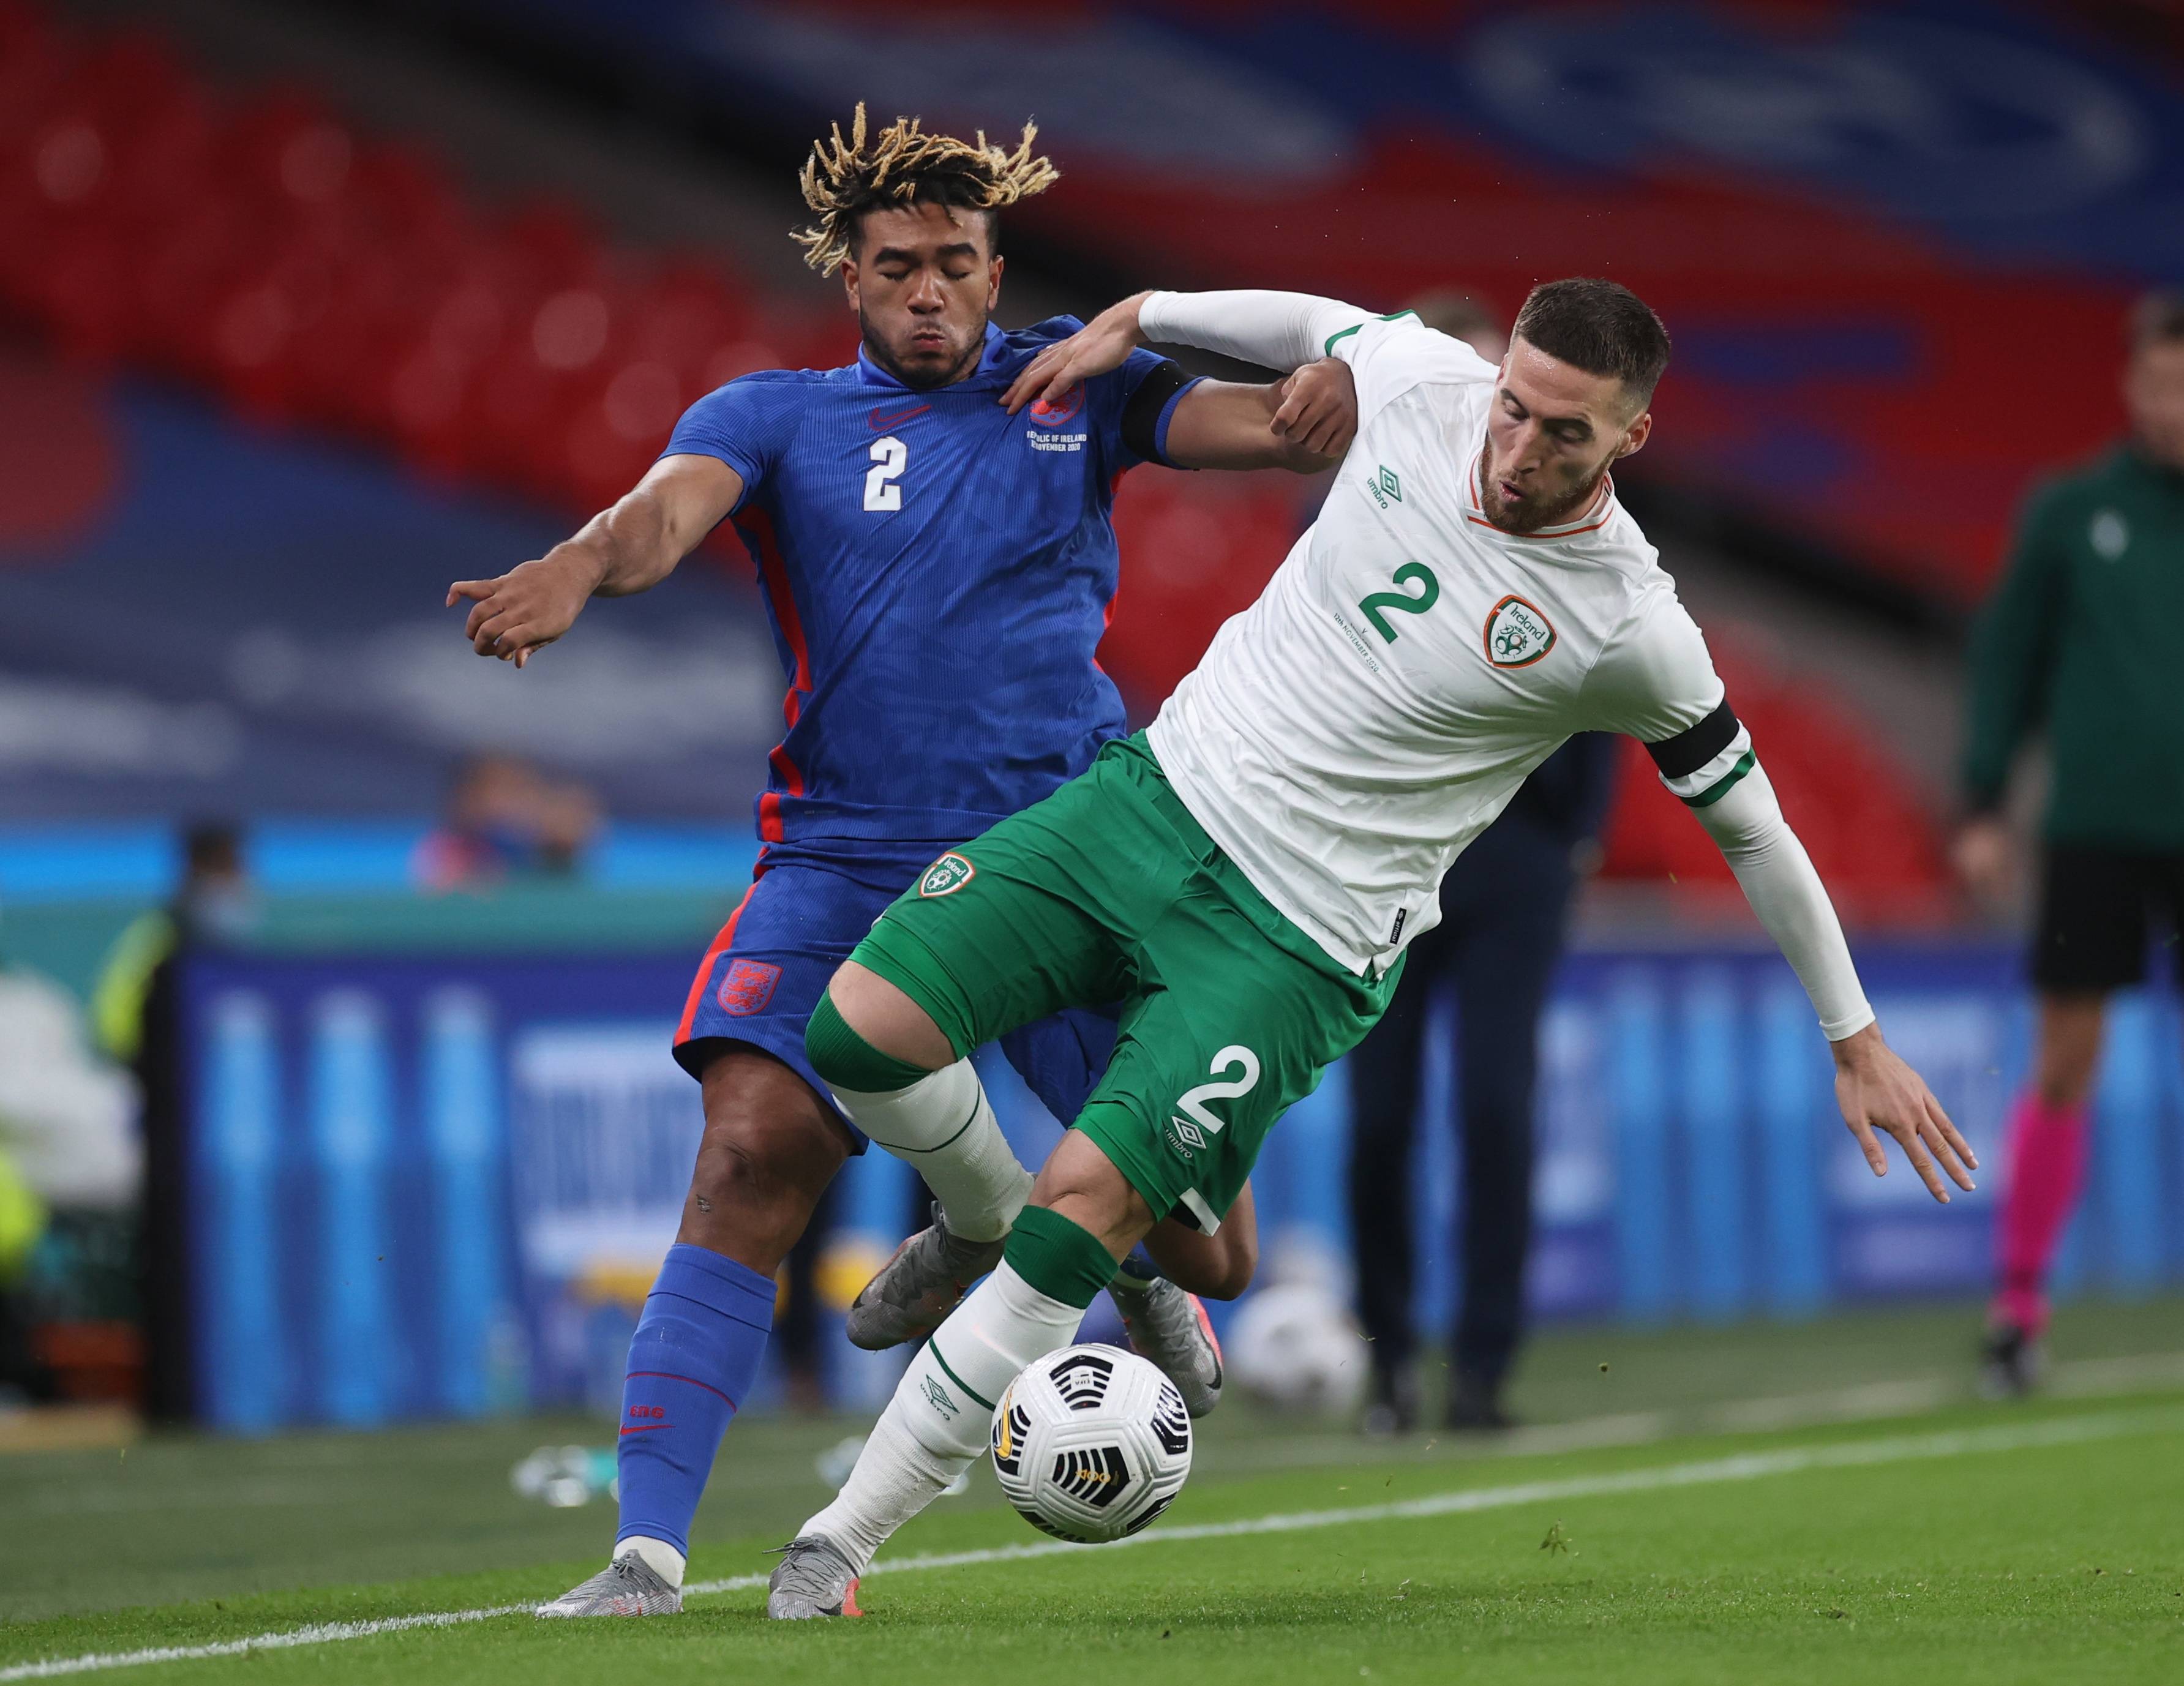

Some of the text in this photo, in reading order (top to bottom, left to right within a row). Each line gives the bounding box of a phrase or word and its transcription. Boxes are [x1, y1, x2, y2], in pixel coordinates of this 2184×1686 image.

[1051, 434, 1059, 443] OF
[1067, 443, 1081, 451] 2020
[863, 436, 907, 511] 2
[1367, 477, 1388, 509] umbro
[1358, 562, 1439, 645] 2
[1510, 604, 1545, 640] Ireland
[1342, 624, 1368, 658] NOVEMBER
[1366, 657, 1379, 672] 2020
[944, 857, 966, 876] Ireland
[1391, 921, 1400, 942] official
[1176, 1045, 1260, 1134] 2
[920, 1384, 951, 1421] umbro
